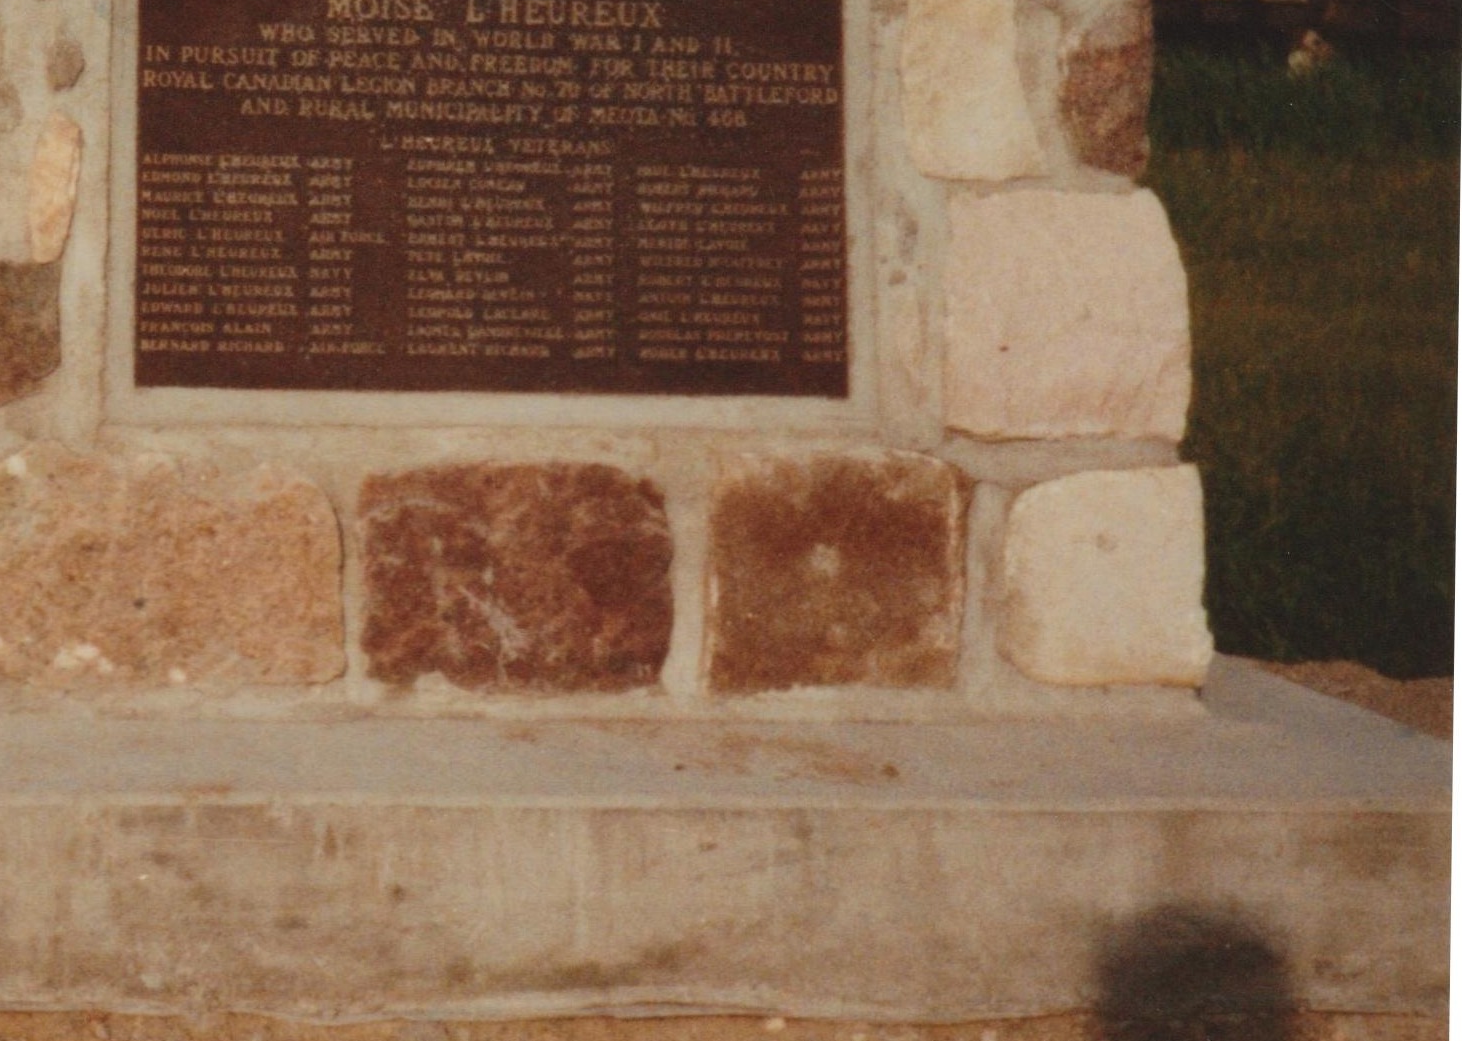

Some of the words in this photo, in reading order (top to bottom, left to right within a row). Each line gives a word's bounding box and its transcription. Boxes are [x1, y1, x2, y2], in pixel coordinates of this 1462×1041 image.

[259, 22, 315, 43] WHO
[326, 24, 420, 46] SERVED
[473, 29, 555, 50] WORLD
[570, 31, 621, 52] WAR
[653, 34, 700, 54] AND
[146, 45, 170, 64] IN
[180, 46, 277, 67] PURSUIT
[291, 49, 320, 68] OF
[327, 50, 400, 70] PEACE
[469, 54, 573, 75] FREEDOM
[589, 57, 634, 76] FOR
[646, 59, 715, 79] THEIR
[726, 61, 834, 82] COUNTRY
[142, 70, 214, 89] ROYAL
[222, 72, 331, 92] CANADIAN
[341, 75, 416, 95] LEGION
[426, 77, 510, 97] BRANCH
[588, 82, 614, 100] OF
[623, 83, 690, 102] NORTH
[703, 85, 838, 106] BATTLEFORD
[240, 97, 288, 117] AND
[299, 98, 373, 120] RURAL
[385, 101, 543, 124] MUNICIPALITY
[552, 105, 578, 125] OF
[510, 137, 612, 155] VETERANS
